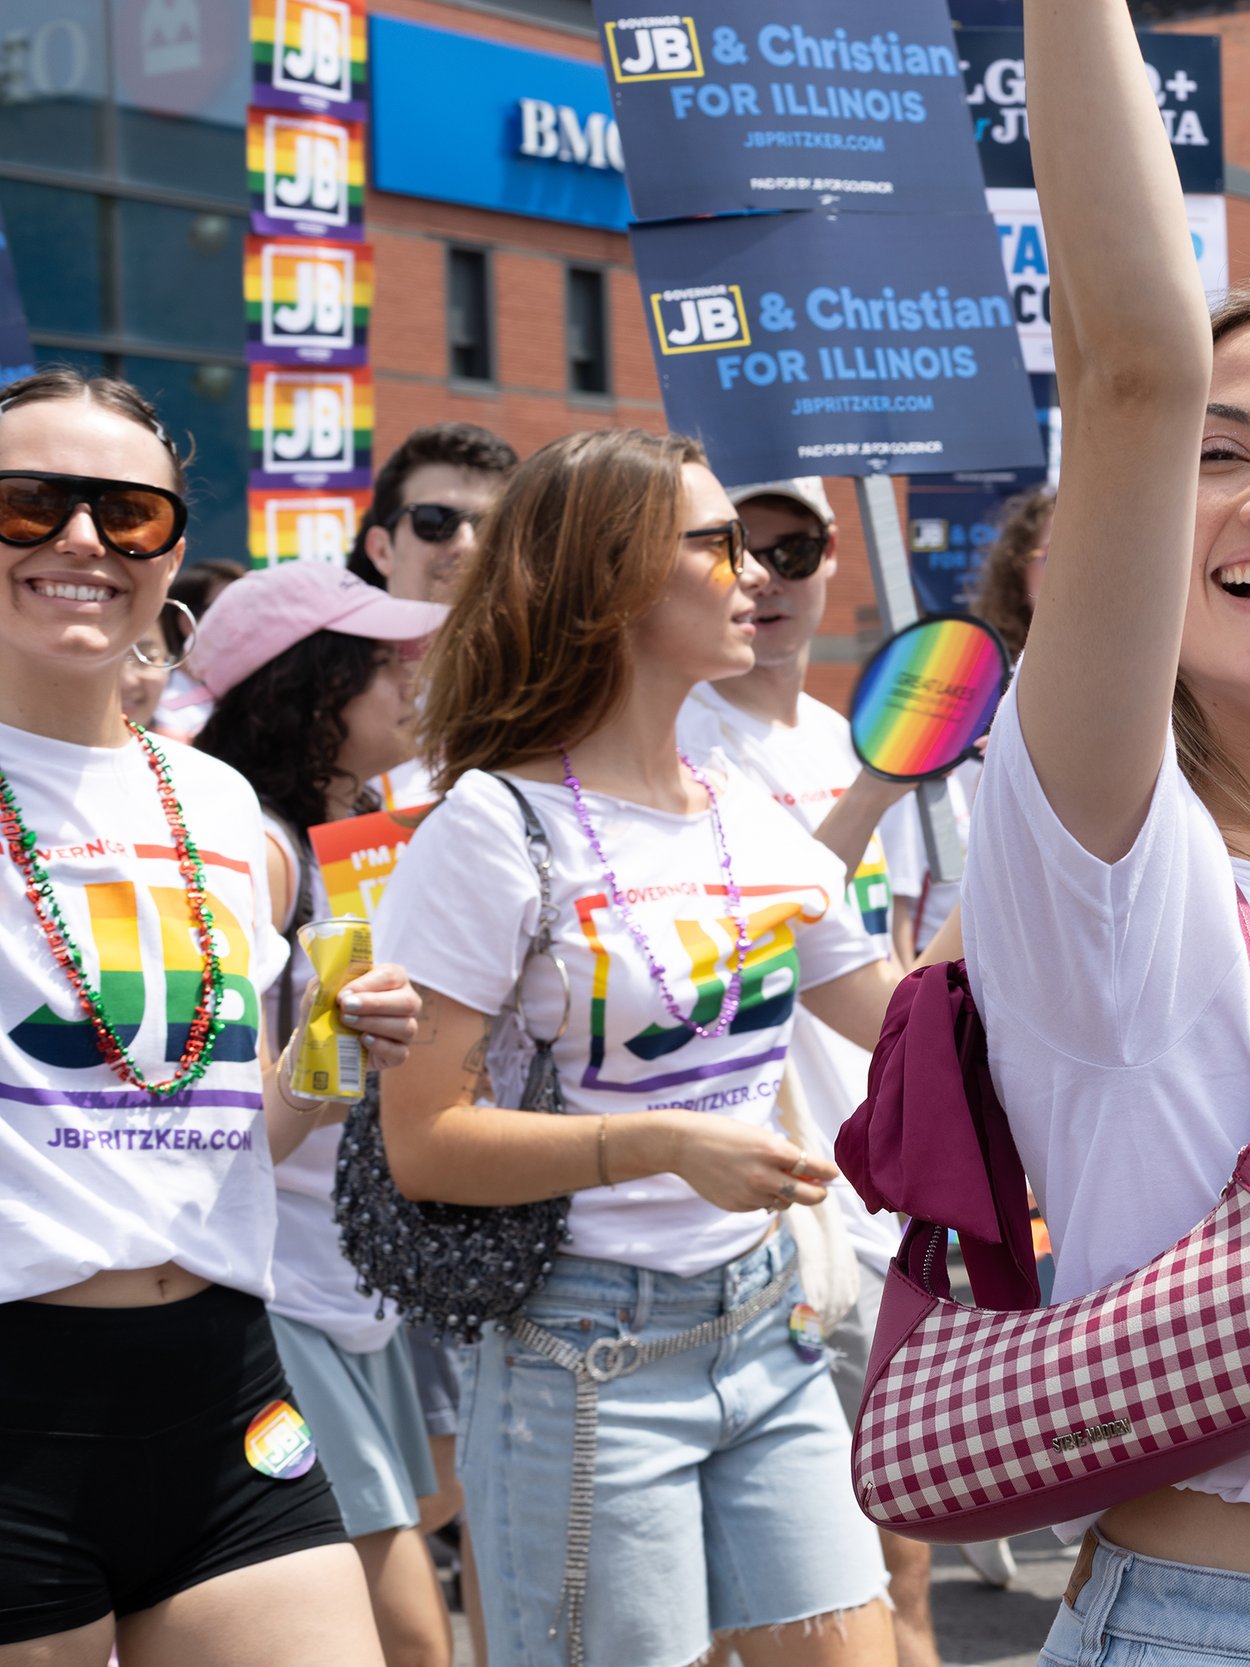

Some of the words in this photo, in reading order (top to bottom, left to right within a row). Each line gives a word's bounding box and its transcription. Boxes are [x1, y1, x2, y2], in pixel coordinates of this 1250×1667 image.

[285, 8, 341, 86] JB
[621, 27, 693, 74] JB
[712, 26, 748, 65] &
[758, 24, 957, 77] Christian
[670, 84, 760, 120] FOR
[771, 83, 928, 124] ILLINOIS
[745, 131, 886, 152] JBPRITZKER.COM
[275, 134, 339, 210] JB
[274, 262, 343, 334] JB
[667, 297, 738, 346] JB
[759, 291, 797, 331] &
[806, 286, 1013, 331] Christian
[716, 349, 808, 391] FOR
[819, 345, 979, 383] ILLINOIS
[274, 387, 343, 460] JB
[791, 395, 934, 416] JBPRITZKER.COM
[351, 844, 391, 871] I'M
[8, 880, 259, 1069] JB
[1052, 1430, 1088, 1454] STEVE
[1085, 1417, 1133, 1444] MADDEN
